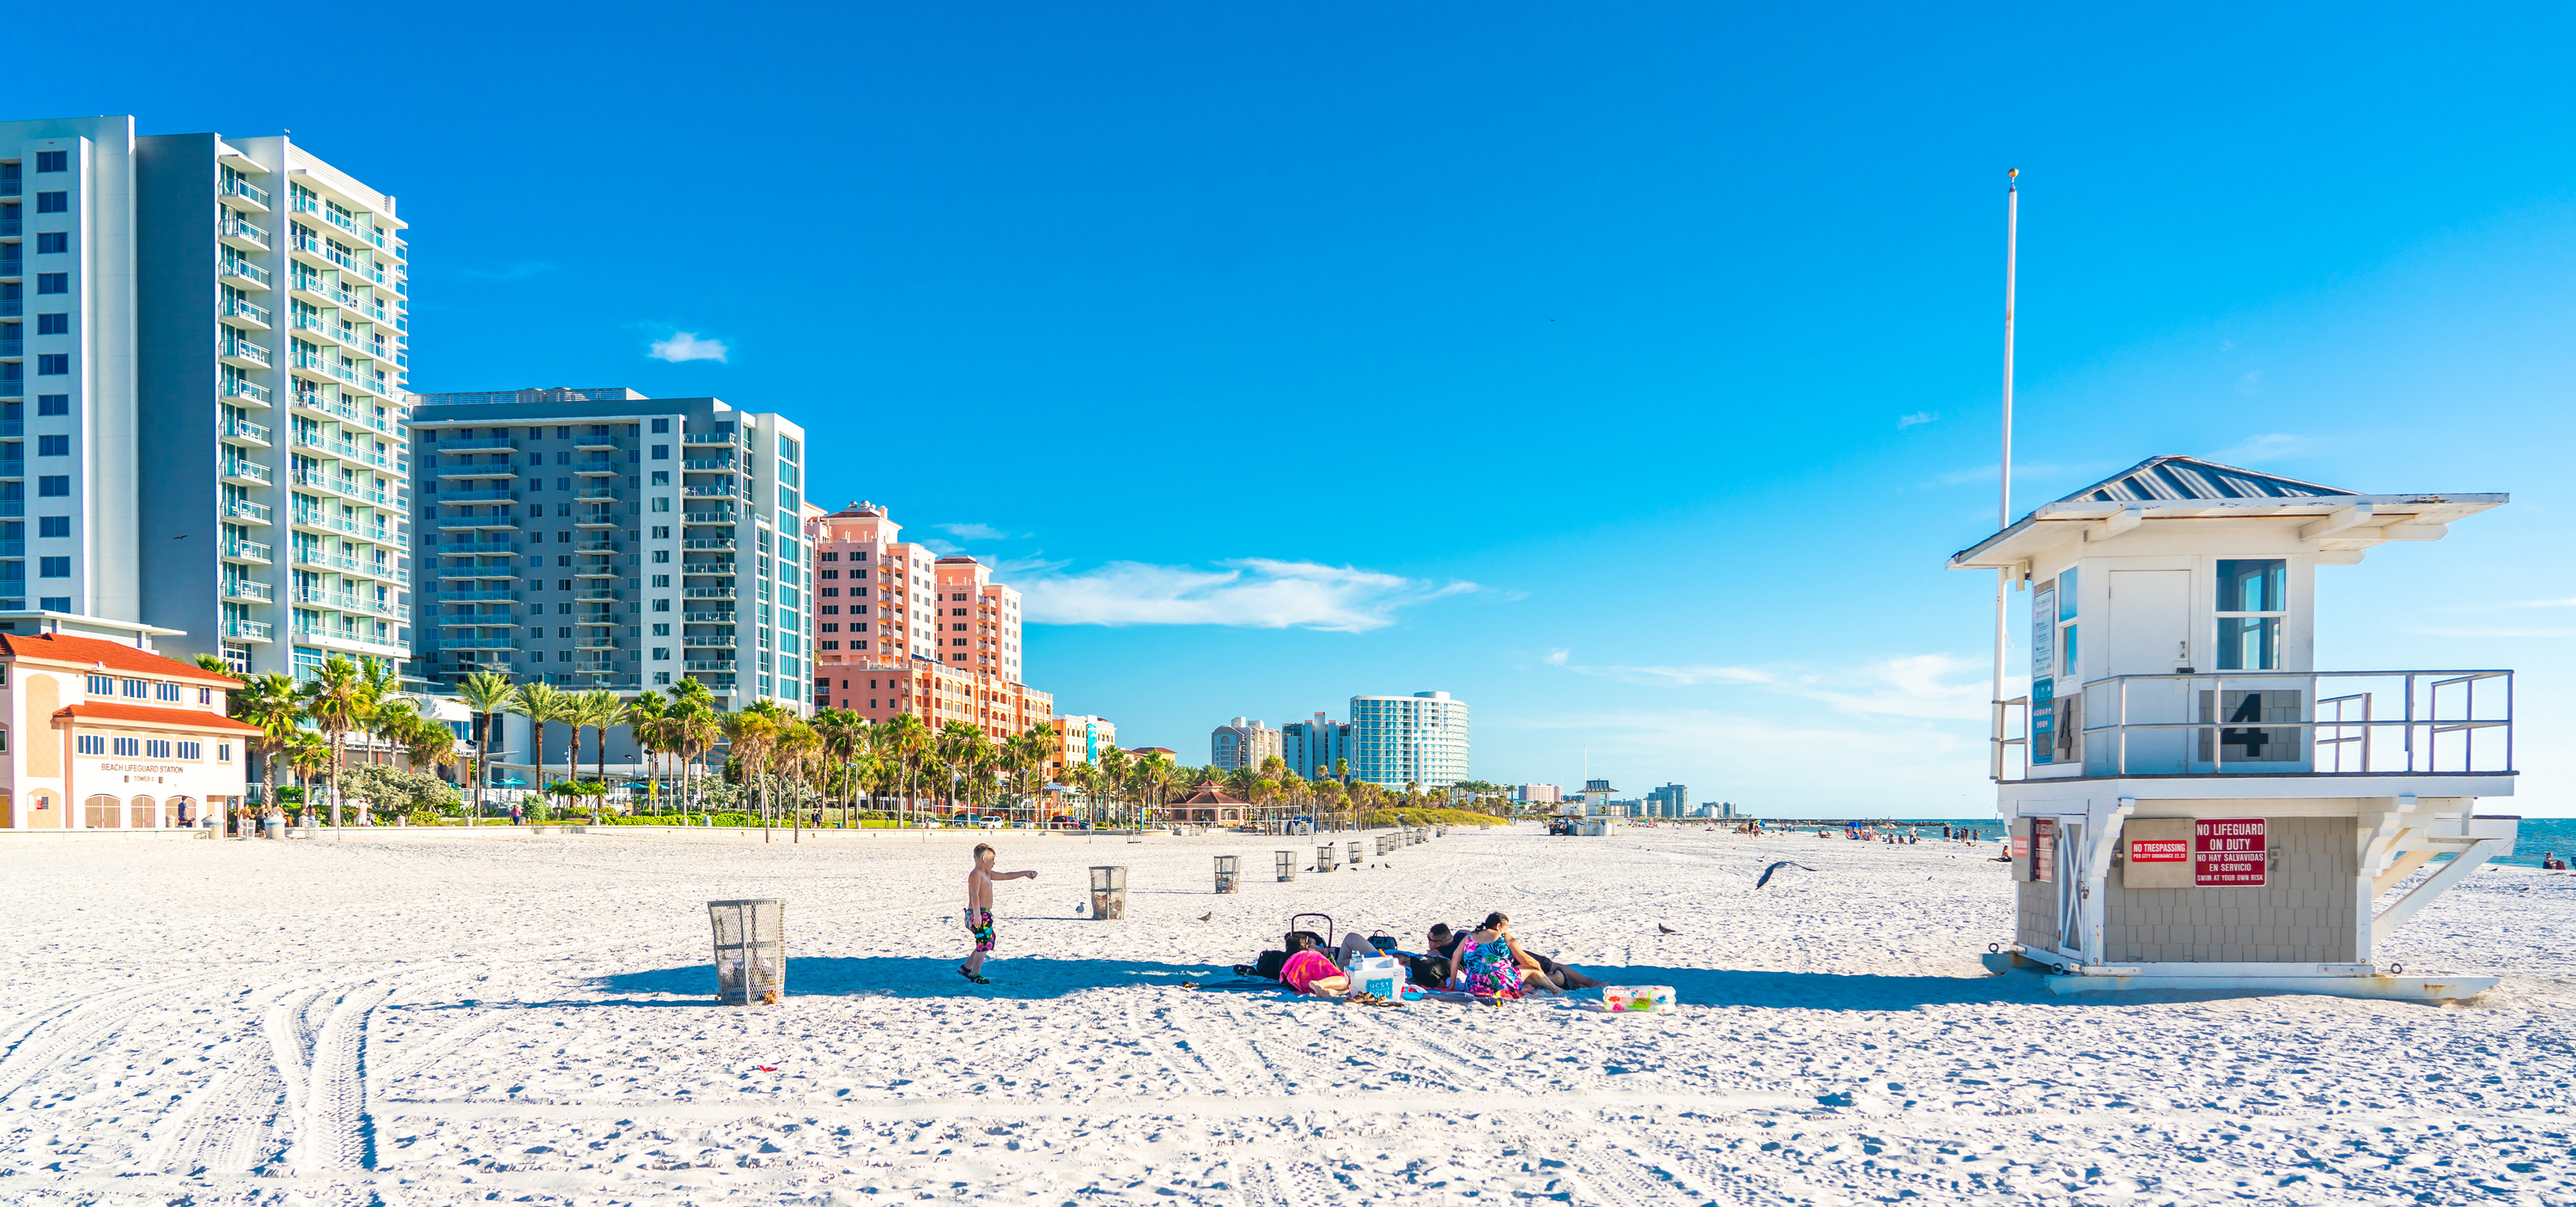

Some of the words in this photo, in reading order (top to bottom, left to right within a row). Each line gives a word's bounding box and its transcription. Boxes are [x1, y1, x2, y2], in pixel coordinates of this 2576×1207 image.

[2057, 698, 2073, 760] 4
[2221, 693, 2269, 757] 4
[101, 763, 123, 772] BEACH
[125, 764, 159, 773] LIFEGUARD
[2196, 823, 2209, 836] NO
[2213, 823, 2263, 836] LIFEGUARD
[2133, 843, 2142, 852] NO
[2143, 843, 2186, 852] TRESPASSING
[2209, 838, 2223, 851] ON
[2227, 838, 2251, 851] DUTY
[2196, 853, 2207, 862] NO
[2208, 853, 2221, 862] HAY
[2223, 852, 2263, 862] SALVAVIDAS
[2208, 863, 2219, 871] EN
[2221, 863, 2251, 871] SERVICIO
